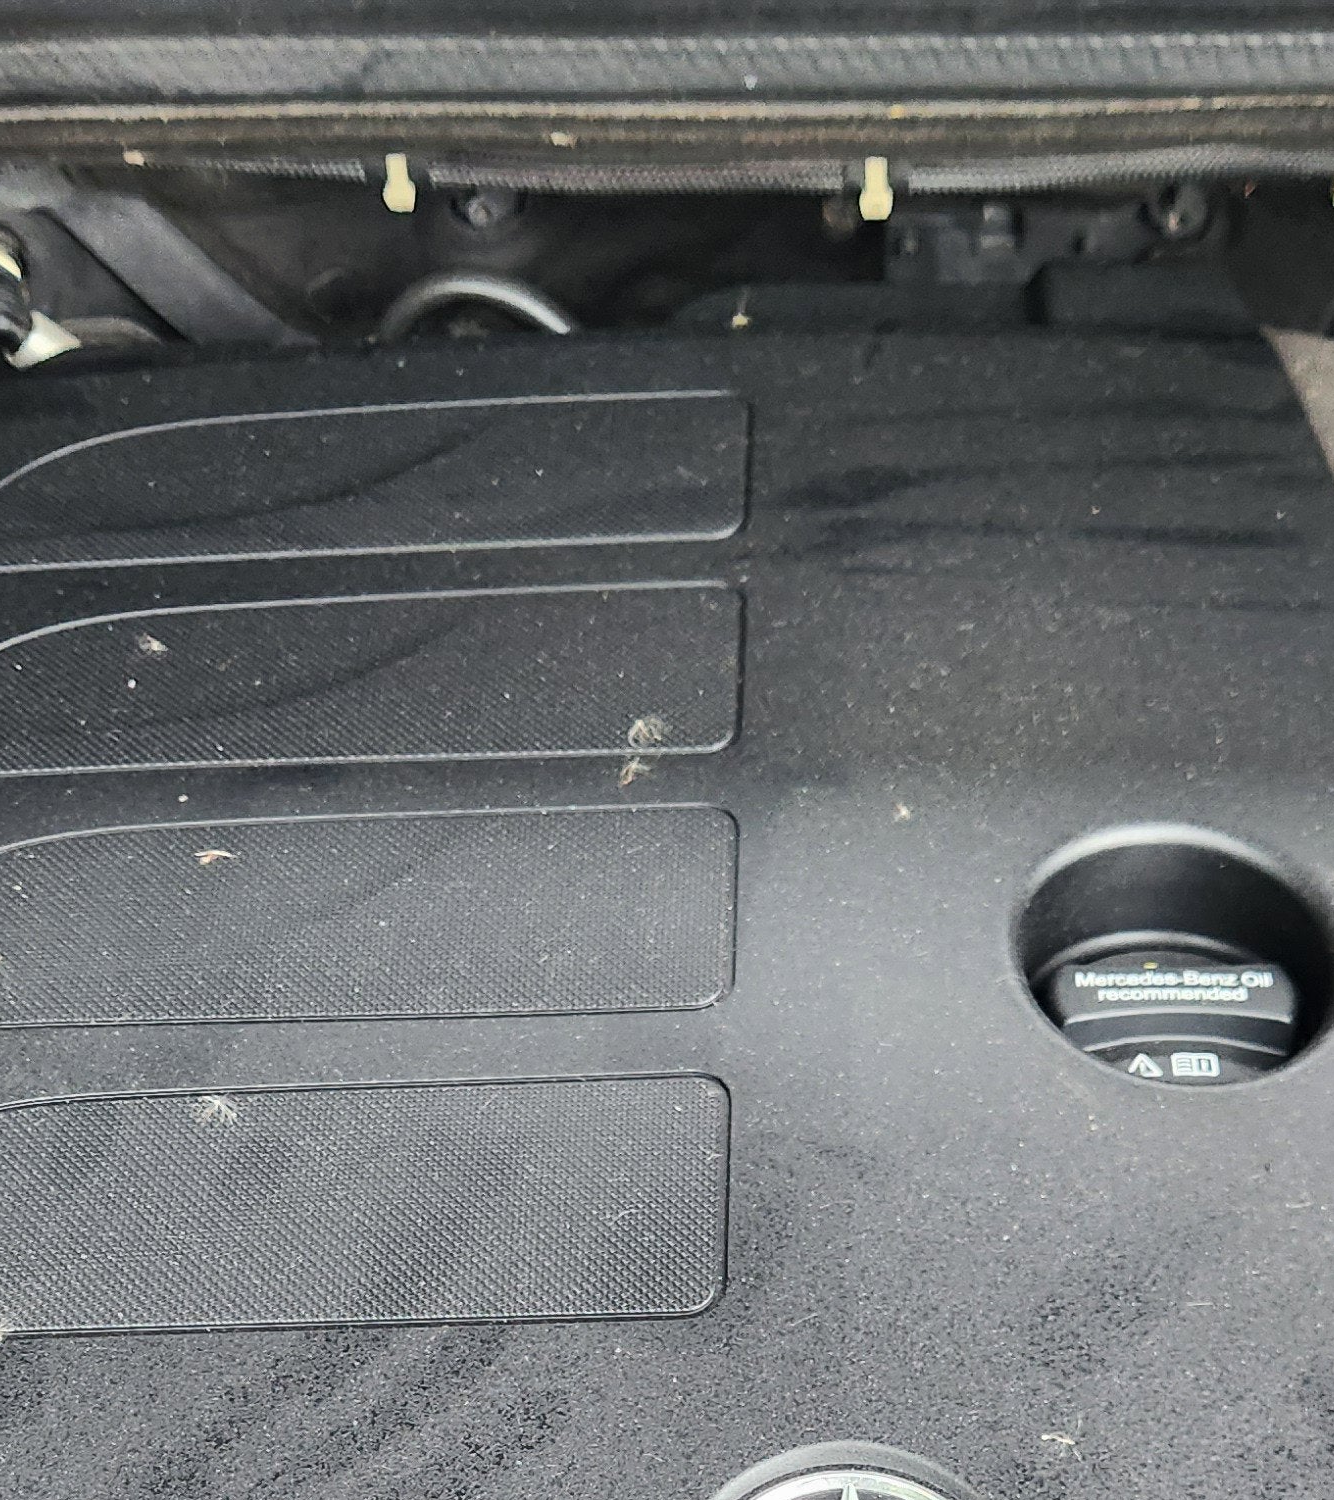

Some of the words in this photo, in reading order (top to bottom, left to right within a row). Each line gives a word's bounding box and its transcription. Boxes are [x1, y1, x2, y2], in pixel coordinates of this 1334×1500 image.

[1075, 970, 1239, 987] Mercedes-Benz
[1240, 971, 1273, 988] Oil
[1097, 986, 1248, 1001] recommended
